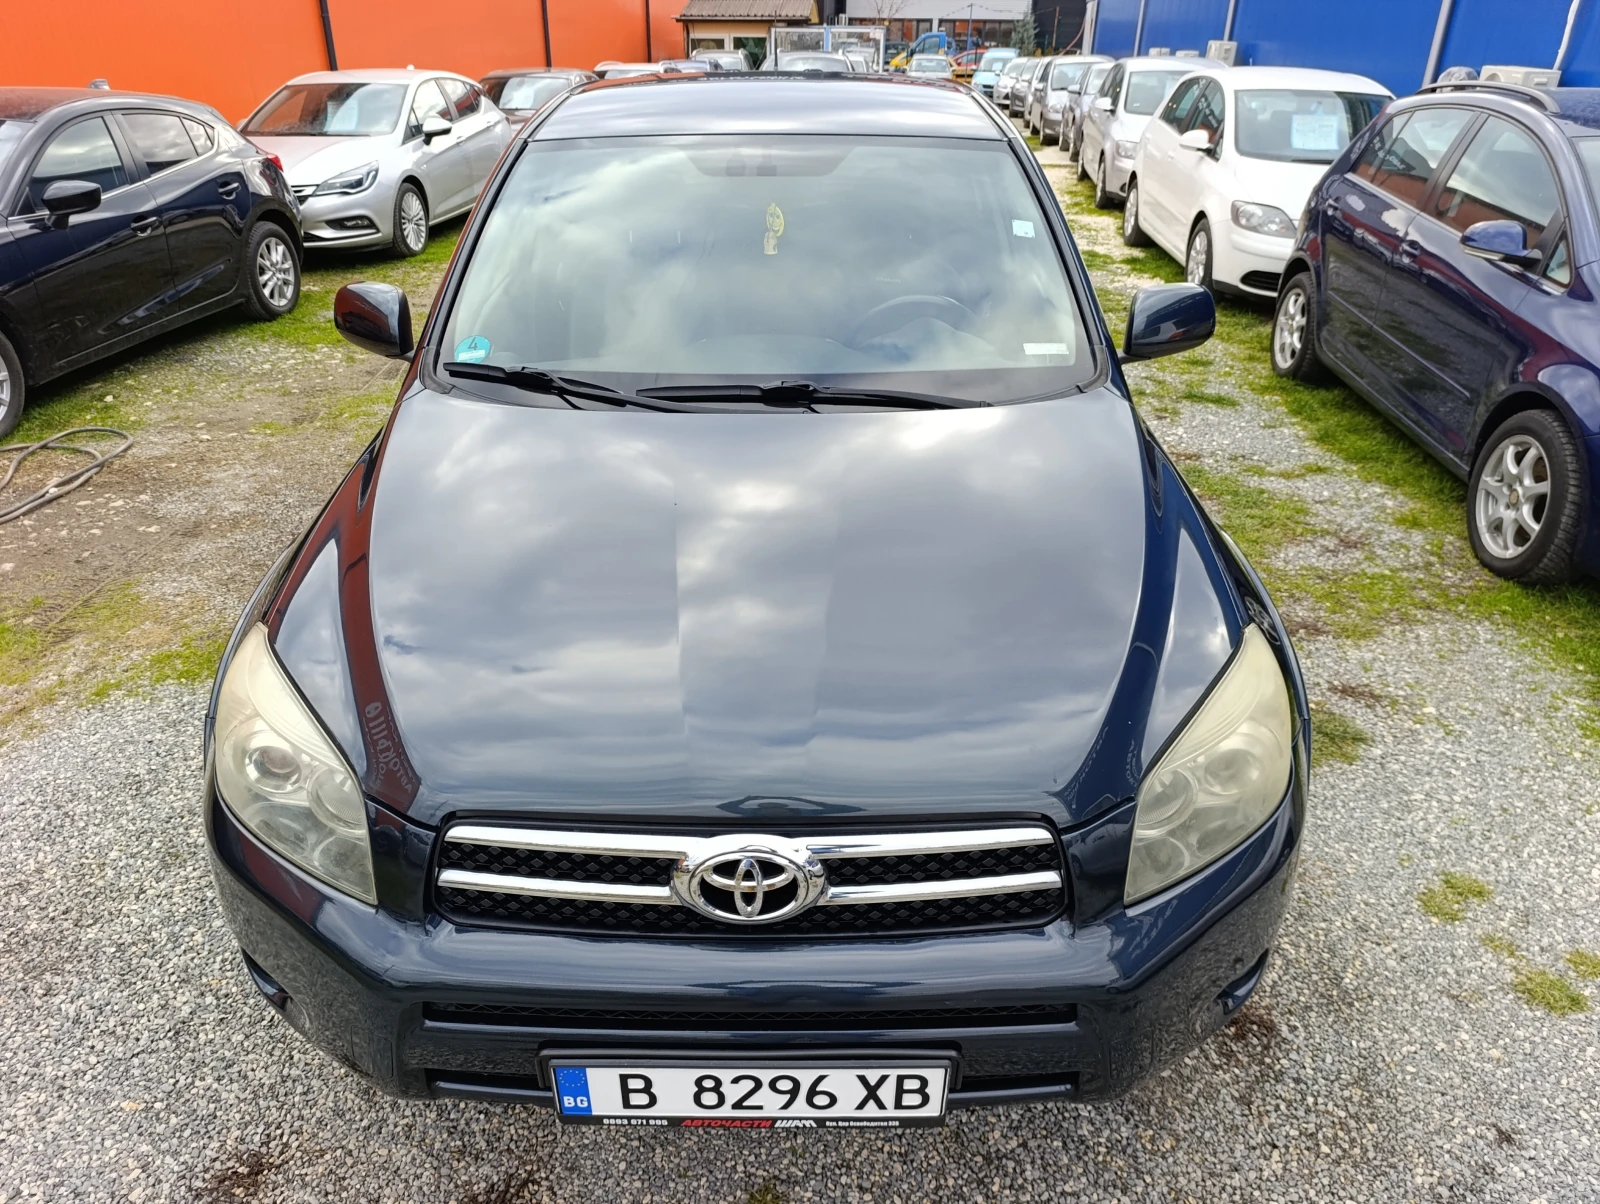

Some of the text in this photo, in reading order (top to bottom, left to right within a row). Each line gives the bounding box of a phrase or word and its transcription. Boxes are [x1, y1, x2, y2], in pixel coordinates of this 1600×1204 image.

[467, 336, 478, 351] 4
[618, 1073, 931, 1111] B 8296 XB
[563, 1095, 589, 1108] BG
[681, 1119, 773, 1128] АВТОЧАСТИ
